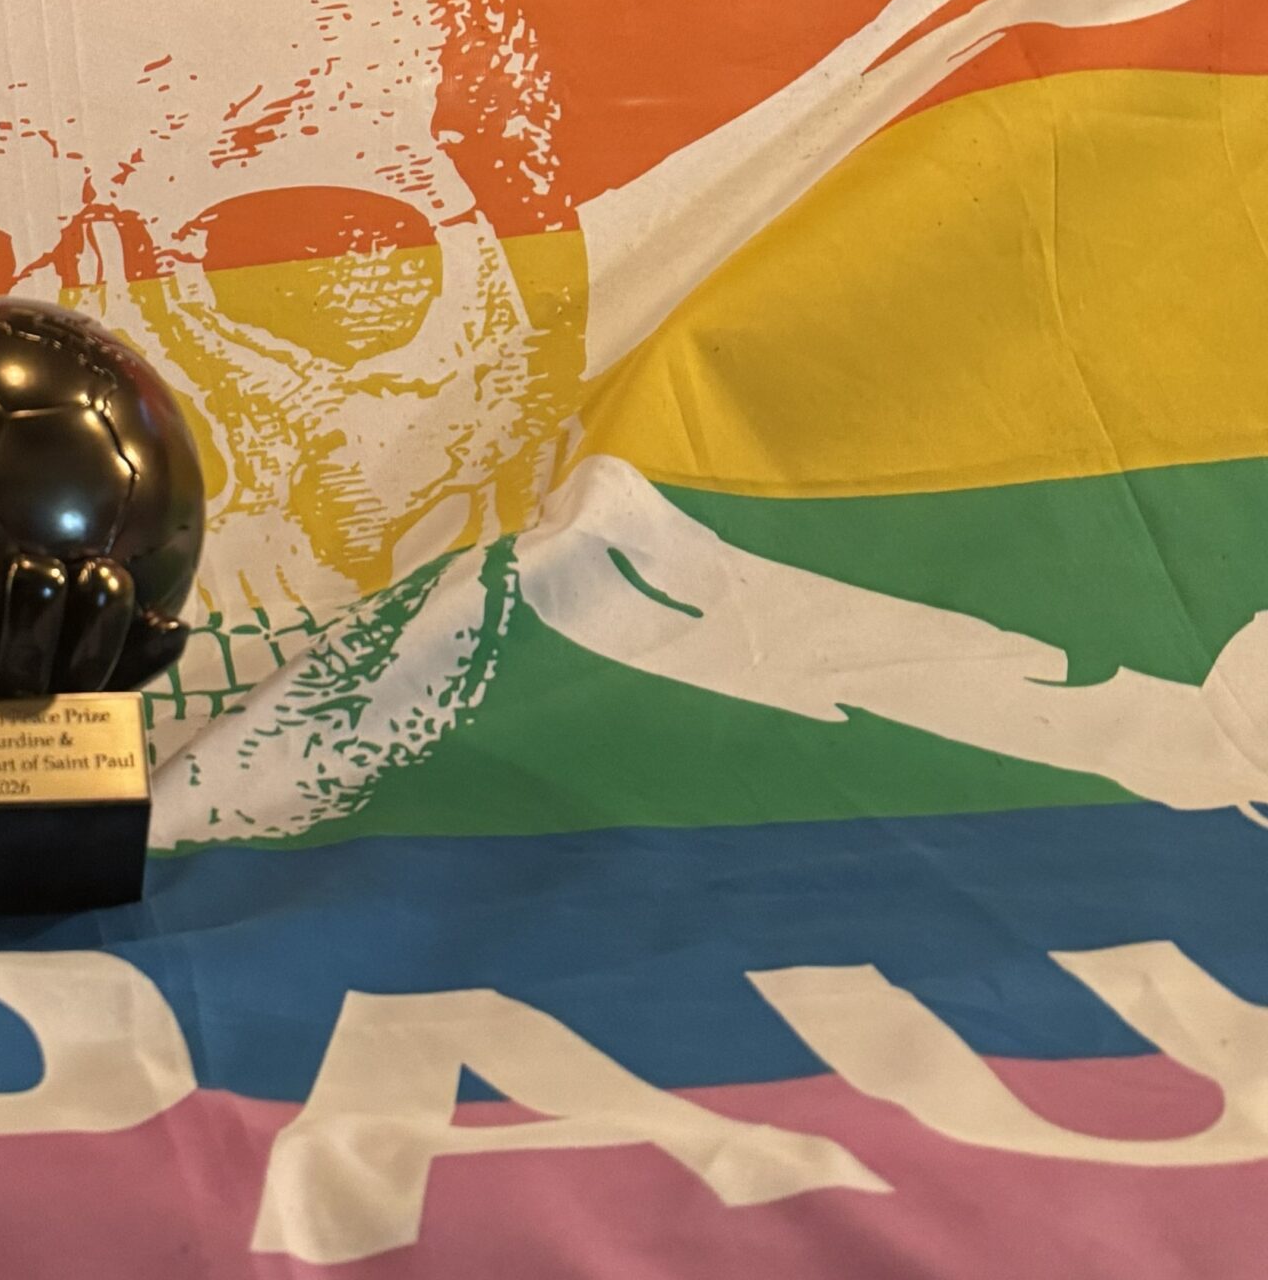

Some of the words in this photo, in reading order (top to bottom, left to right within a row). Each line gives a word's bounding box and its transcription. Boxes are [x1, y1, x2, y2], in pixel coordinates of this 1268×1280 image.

[64, 707, 111, 725] Prize
[59, 733, 74, 747] &
[21, 755, 39, 771] of
[43, 753, 92, 770] Saint
[94, 752, 135, 769] Paul
